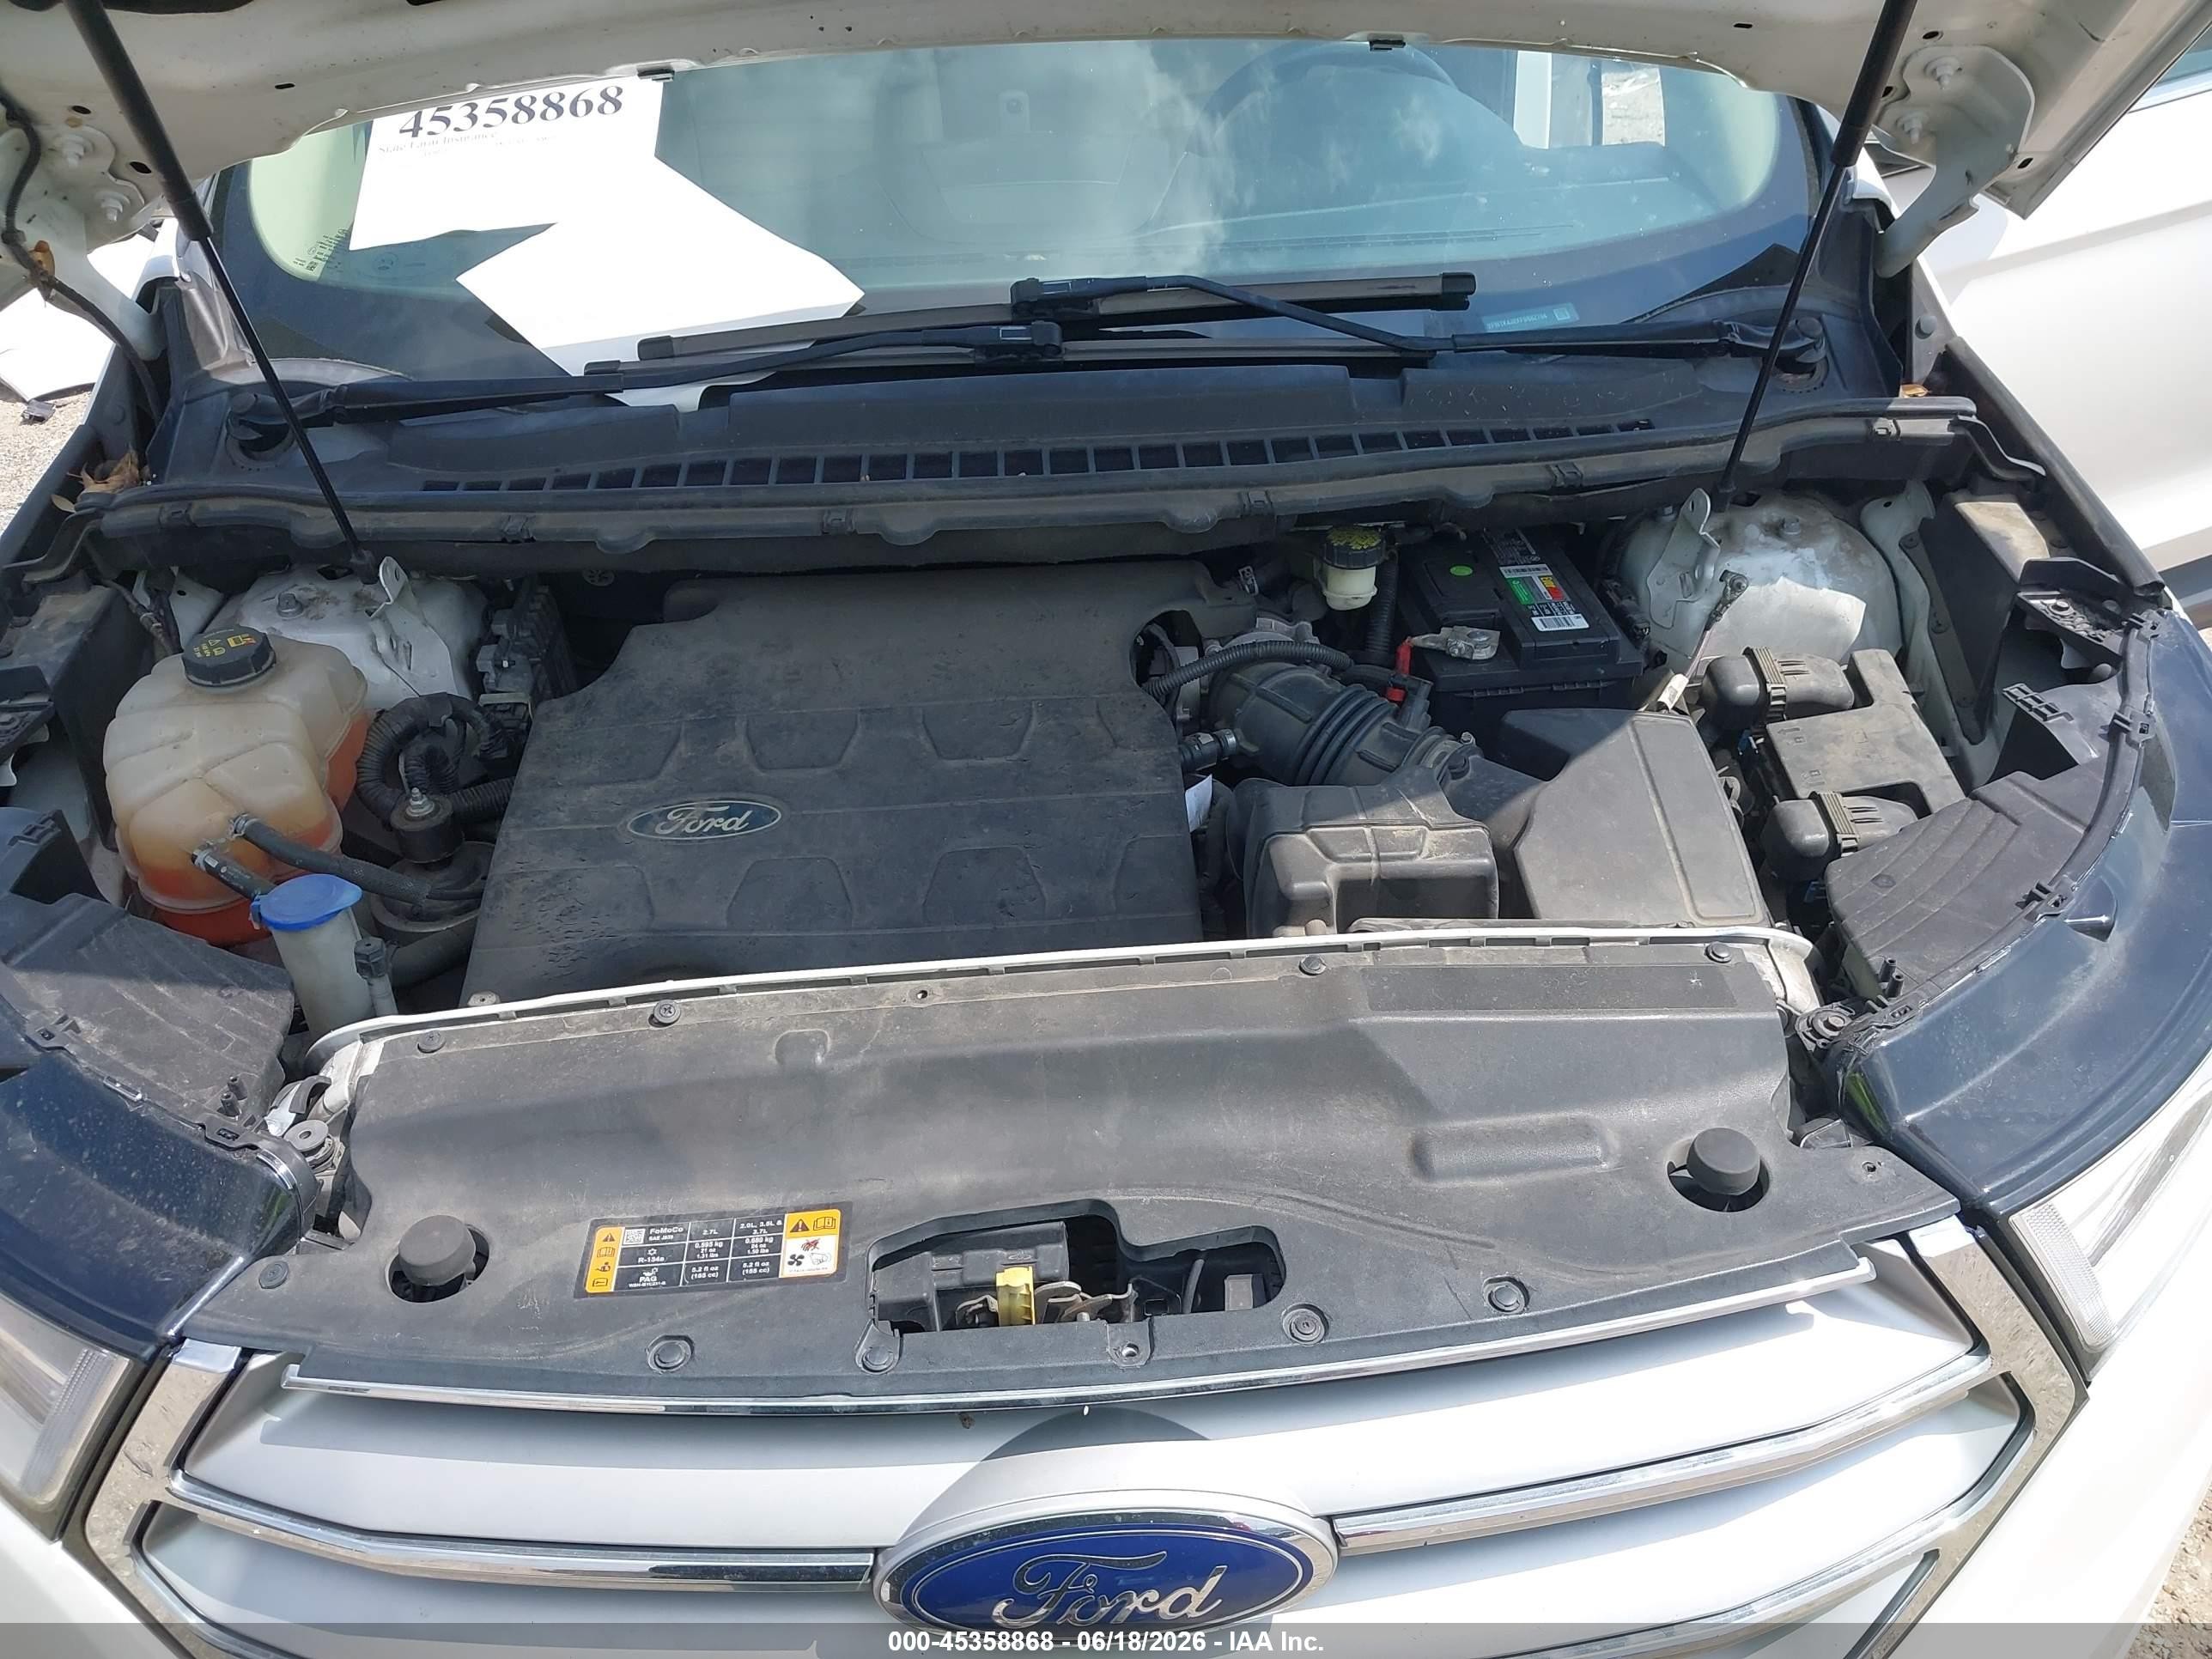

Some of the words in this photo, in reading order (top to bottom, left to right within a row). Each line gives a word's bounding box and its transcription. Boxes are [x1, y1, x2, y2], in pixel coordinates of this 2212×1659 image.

[399, 86, 623, 137] 45358868
[655, 805, 752, 835] Ford
[638, 1255, 665, 1264] R-134a
[991, 1551, 1228, 1628] Ford
